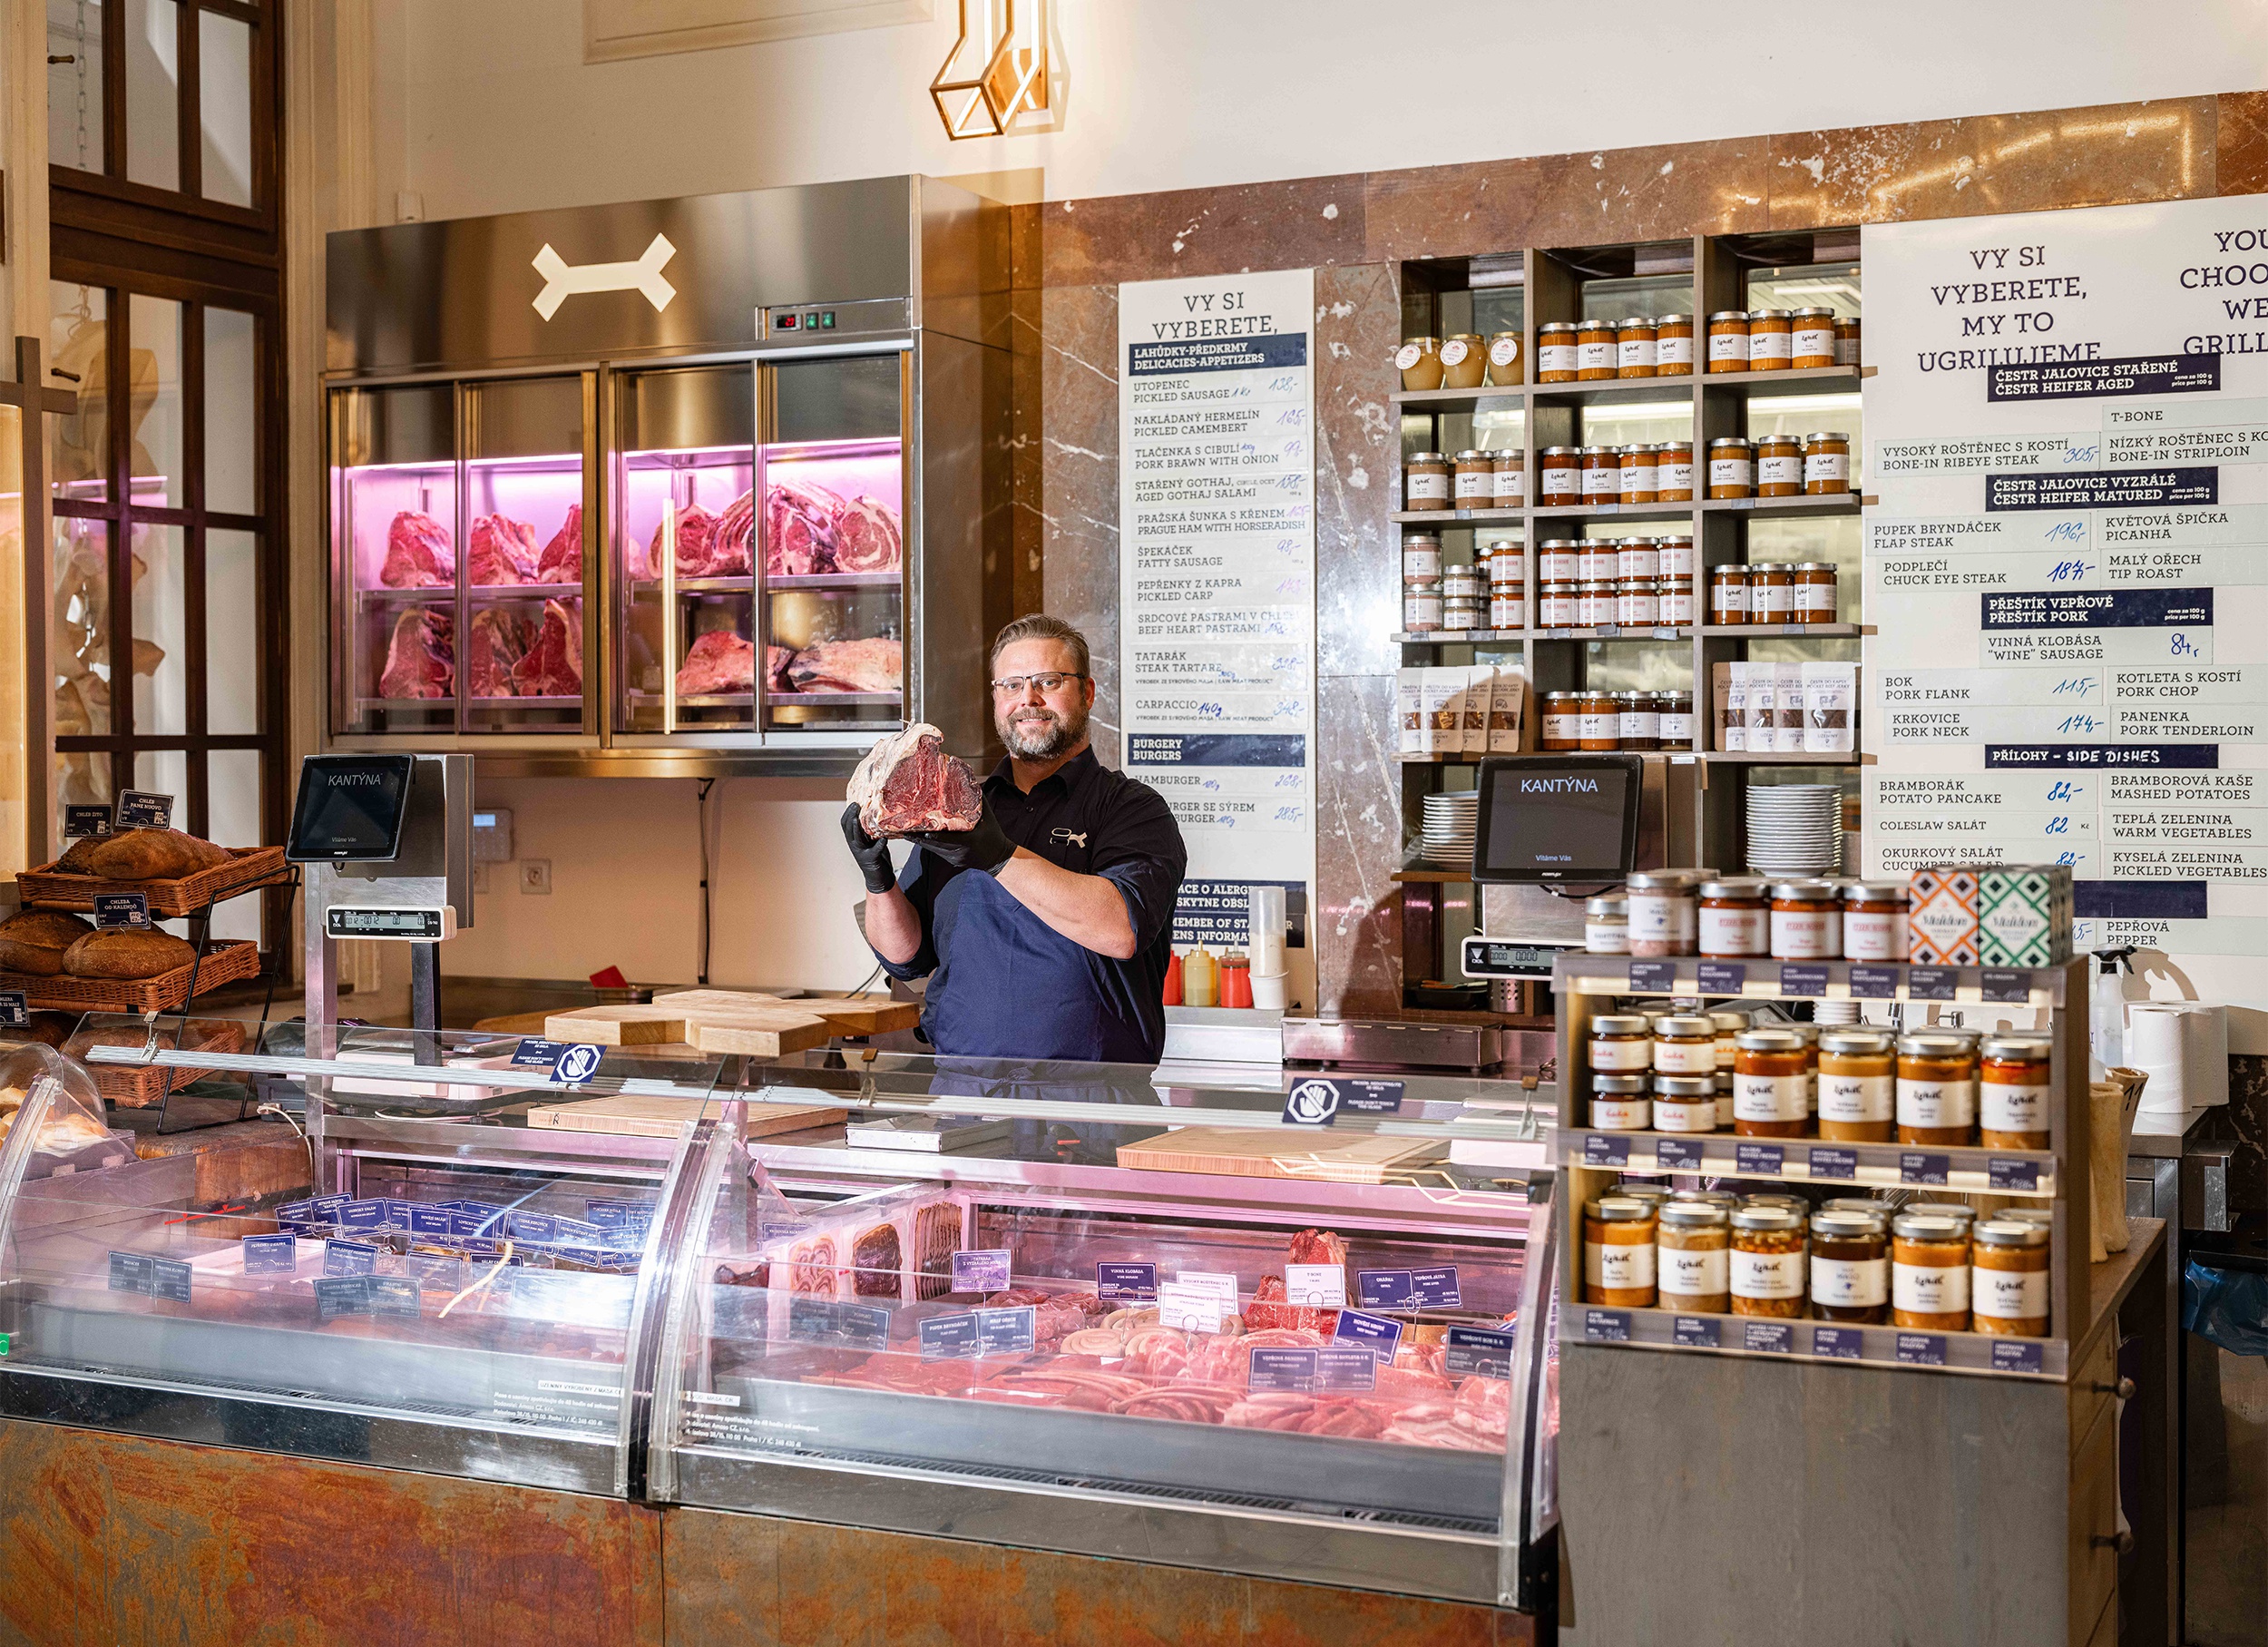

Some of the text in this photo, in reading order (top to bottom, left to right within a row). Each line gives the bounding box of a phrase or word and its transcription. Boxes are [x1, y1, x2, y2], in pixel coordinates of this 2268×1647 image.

[1970, 246, 2045, 270] VY SI
[2180, 264, 2268, 289] CHOO
[1931, 277, 2087, 305] VYBERETE,
[1184, 292, 1244, 312] VY SI
[1152, 316, 1278, 339] VYBERETE,
[1962, 312, 2054, 337] MY TO
[1135, 342, 1248, 358] LAHŮDKY-PŘEDKRMY
[1135, 354, 1265, 370] DELICACIES-APPETIZERS
[1918, 343, 2101, 372] UGRILUJEME
[1996, 359, 2177, 382] ČESTR JALOVICE STAŘENÉ
[1134, 380, 1189, 391] UTOPENEC
[1996, 378, 2134, 396] ČESTR HEIFER AGED
[1134, 389, 1229, 403] PICKLED SAUSAGE
[1134, 413, 1200, 425] NAKLÁDANÝ
[1205, 410, 1260, 422] HERMELÍN
[2111, 411, 2163, 422] T-BONE
[1136, 443, 1239, 458] TLAČENKA S CIBULÍ
[1883, 444, 1936, 456] VYSOKÝ
[1941, 441, 2010, 455] ROŠTĚNEC
[2016, 443, 2022, 451] S
[2028, 438, 2068, 451] KOSTÍ
[1136, 455, 1279, 469] PORK BRAWN WITH ONION
[1883, 456, 2038, 470] BONE-IN RIBEYE STEAK
[1136, 477, 1234, 490] STAŘENÝ GOTHAJ,
[1994, 473, 2175, 492] ČESTR JALOVICE VYZRÁLÉ
[1136, 488, 1256, 502] AGED GOTHAJ SALAMI
[1139, 508, 1285, 524] PRAŽSKÁ ŠUNKA S KŘENEM
[2106, 512, 2229, 527] KVĚTOVÁ ŠPIČKA
[1139, 521, 1305, 535] PRAGUE HAM WITH HORSERADISH
[1874, 524, 1916, 535] PUPEK
[1921, 521, 2001, 534] BRYNDÁČEK
[2106, 529, 2172, 541] PICANHA
[1874, 537, 1953, 549] FLAP STEAK
[1138, 545, 1192, 555] ŠPEKÁČEK
[2109, 552, 2201, 565] MALÝ OŘECH
[1884, 559, 1948, 572] PODPLEČÍ
[1138, 579, 1242, 590] PEPŘENKY Z KAPRA
[1884, 574, 2007, 585] CHUCK EYE STEAK
[1989, 595, 2113, 610] PŘEŠTÍK VEPŘOVÉ
[1139, 623, 1260, 634] BEEF HEART PASTRAMI
[1989, 633, 2102, 647] VINNÁ KLOBÁSA
[1135, 650, 1186, 661] TATARÁK
[1989, 650, 2103, 660] "WINE" SAUSAGE
[1885, 677, 1913, 687] BOK
[2116, 670, 2242, 683] KOTLETA S KOSTÍ
[1885, 690, 1970, 700] PORK FLANK
[1136, 701, 1198, 710] CARPACCIO
[1892, 714, 1960, 724] KRKOVICE
[2120, 712, 2190, 722] PANENKA
[2120, 726, 2253, 736] PORK TENDERLOIN
[1133, 740, 1182, 749] BURGERY
[1133, 750, 1181, 760] BURGERS
[1993, 749, 2160, 763] PŘÍLOHY SIDE DISHES
[328, 772, 381, 786] KANTÝNA
[1521, 776, 1598, 792] KANTÝNA
[1880, 779, 1964, 790] BRAMBORÁK
[2111, 774, 2253, 786] BRAMBOROVÁ KAŠE
[1880, 794, 2001, 804] POTATO PANCAKE
[1204, 803, 1216, 811] SE
[1219, 801, 1255, 812] SÝREM
[1880, 821, 1943, 830] COLESLAW
[1948, 819, 1986, 830] SALÁT
[2113, 812, 2233, 824] TEPLÁ ZELENINA
[1882, 846, 2003, 858] OKURKOVÝ SALÁT
[2113, 851, 2244, 864] KYSELÁ ZELENINA
[2113, 866, 2267, 877] PICKLED VEGETABLES
[1217, 918, 1231, 928] OF
[2107, 920, 2169, 932] PEPŘOVÁ
[2107, 936, 2157, 946] PEPPER
